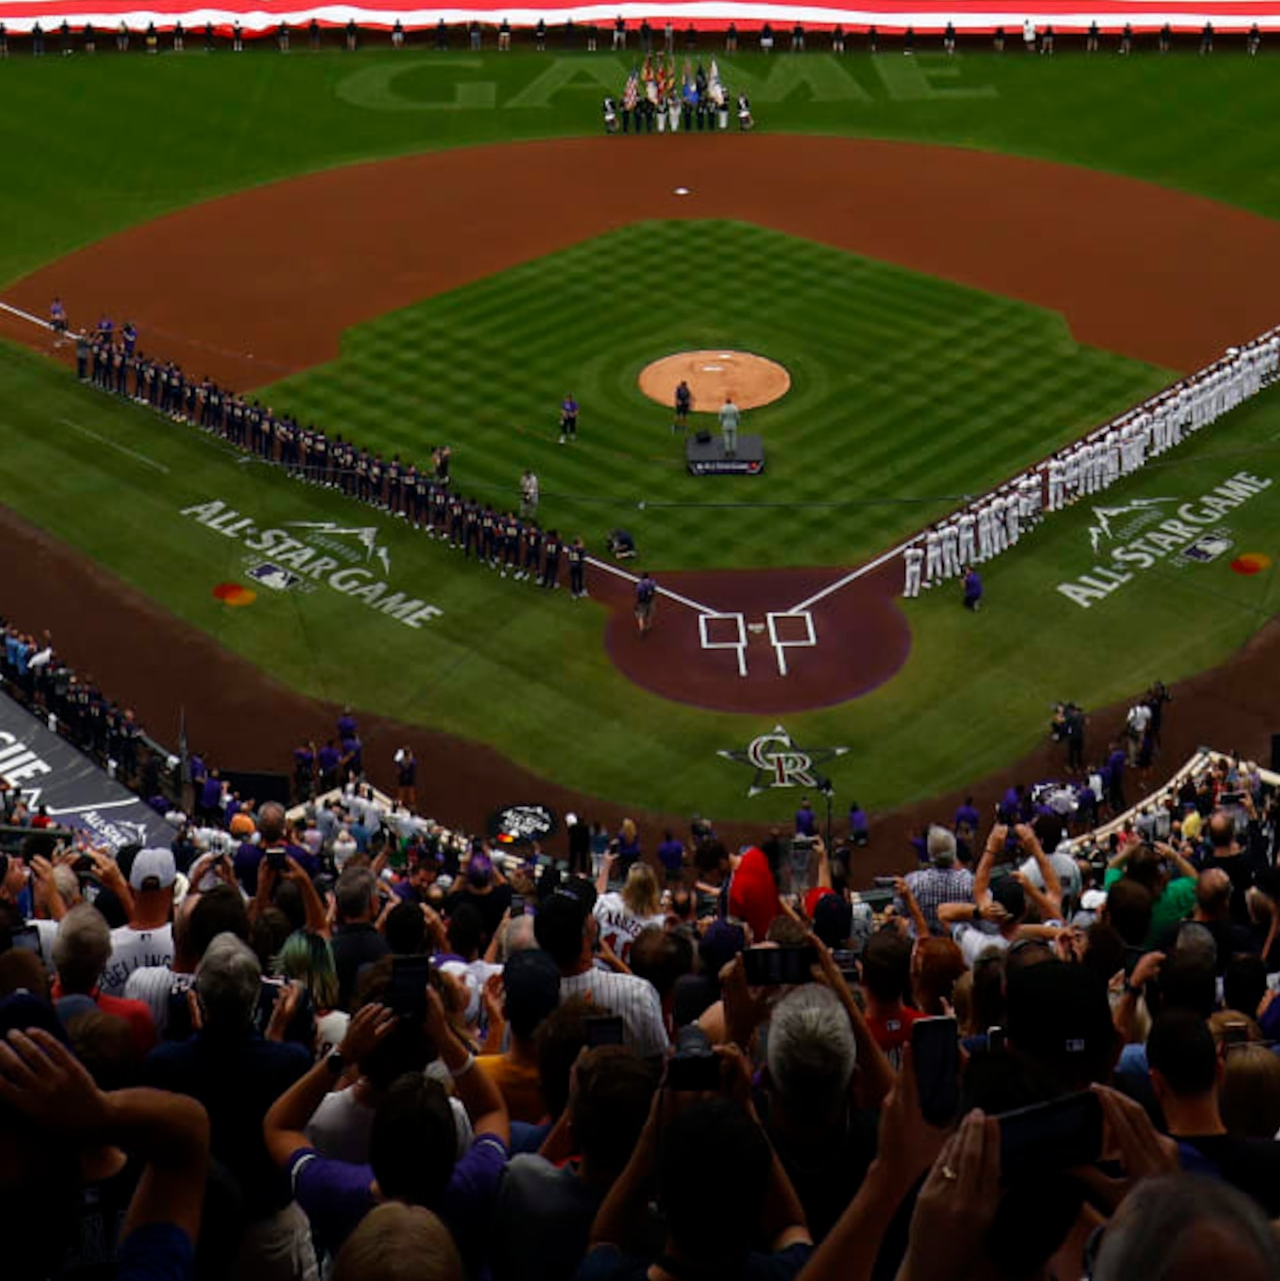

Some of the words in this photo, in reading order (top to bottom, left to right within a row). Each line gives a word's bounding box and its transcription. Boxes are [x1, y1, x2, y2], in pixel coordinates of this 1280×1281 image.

[335, 54, 1002, 110] GAME
[1176, 471, 1273, 524] GAME
[328, 567, 444, 629] GAME
